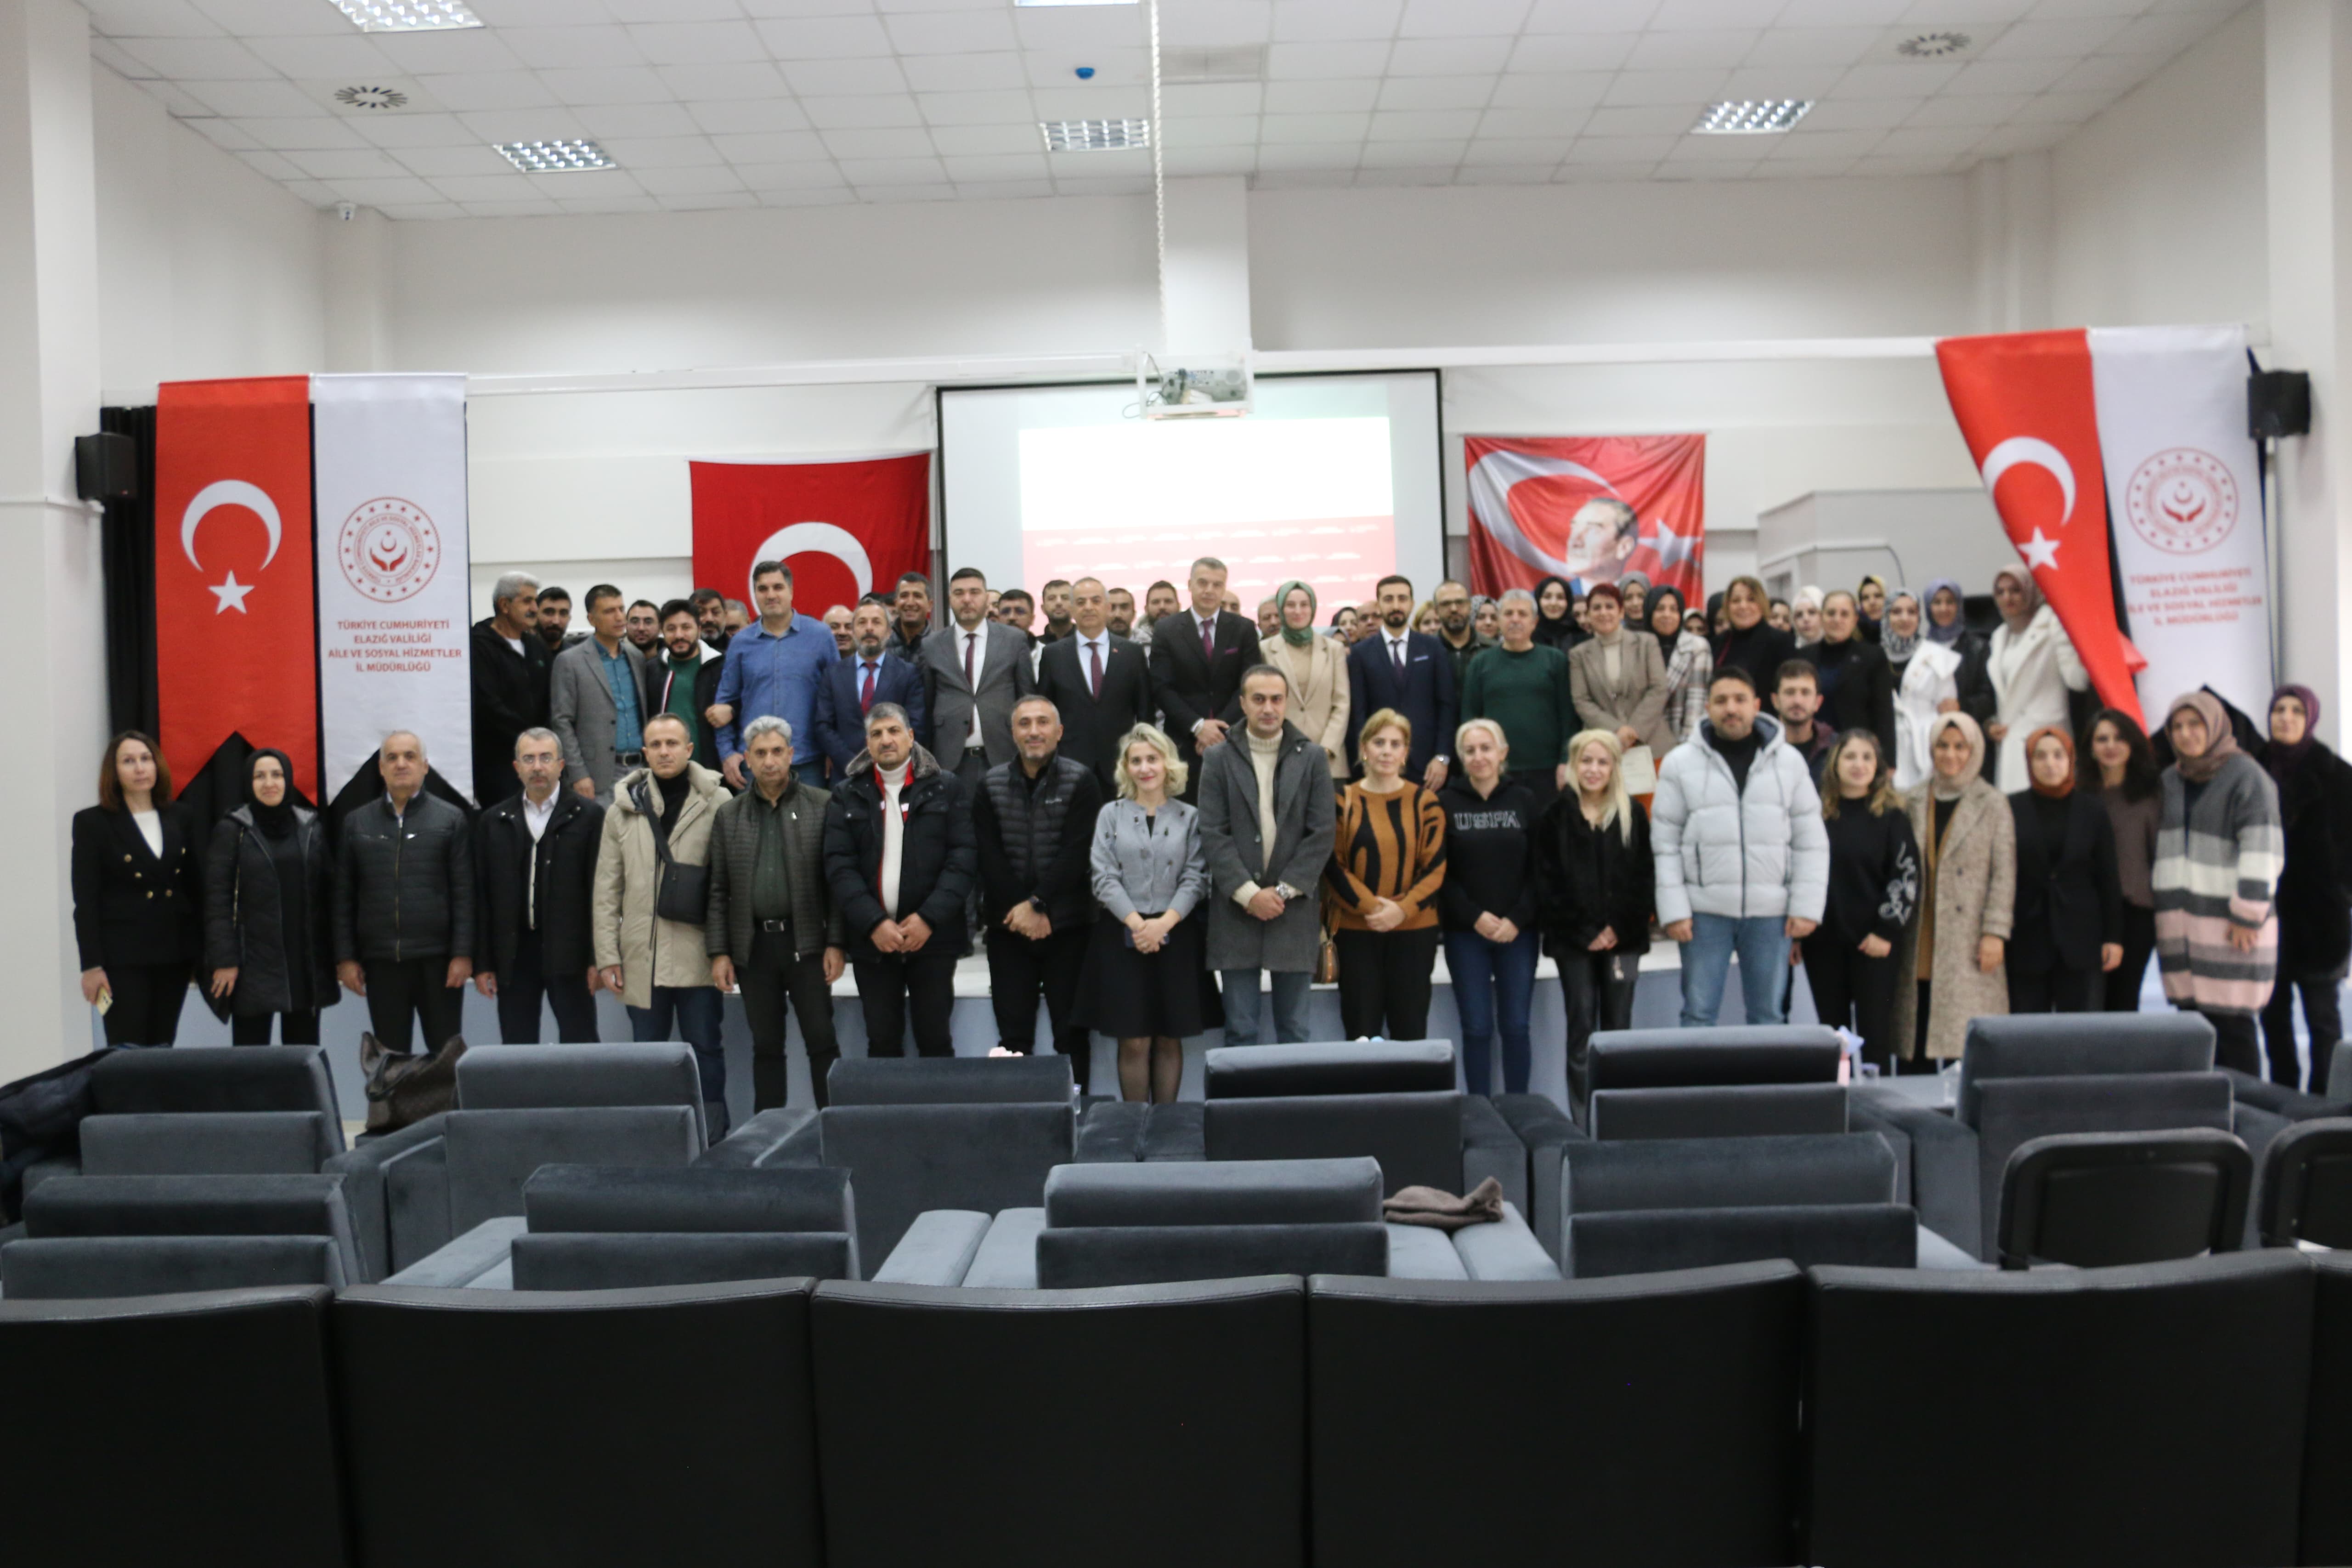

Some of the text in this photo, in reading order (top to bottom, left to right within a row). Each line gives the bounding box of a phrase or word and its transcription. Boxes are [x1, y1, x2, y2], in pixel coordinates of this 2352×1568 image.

[338, 619, 449, 629] TÜRKİYE CUMHURİYETİ
[354, 633, 431, 644] ELAZIĞ VALİLİĞİ
[328, 648, 347, 658] AİLE
[365, 649, 399, 658] SOSYAL
[403, 648, 462, 658] HİZMETLER
[356, 661, 430, 672] İL MÜDÜRLÜĞÜ
